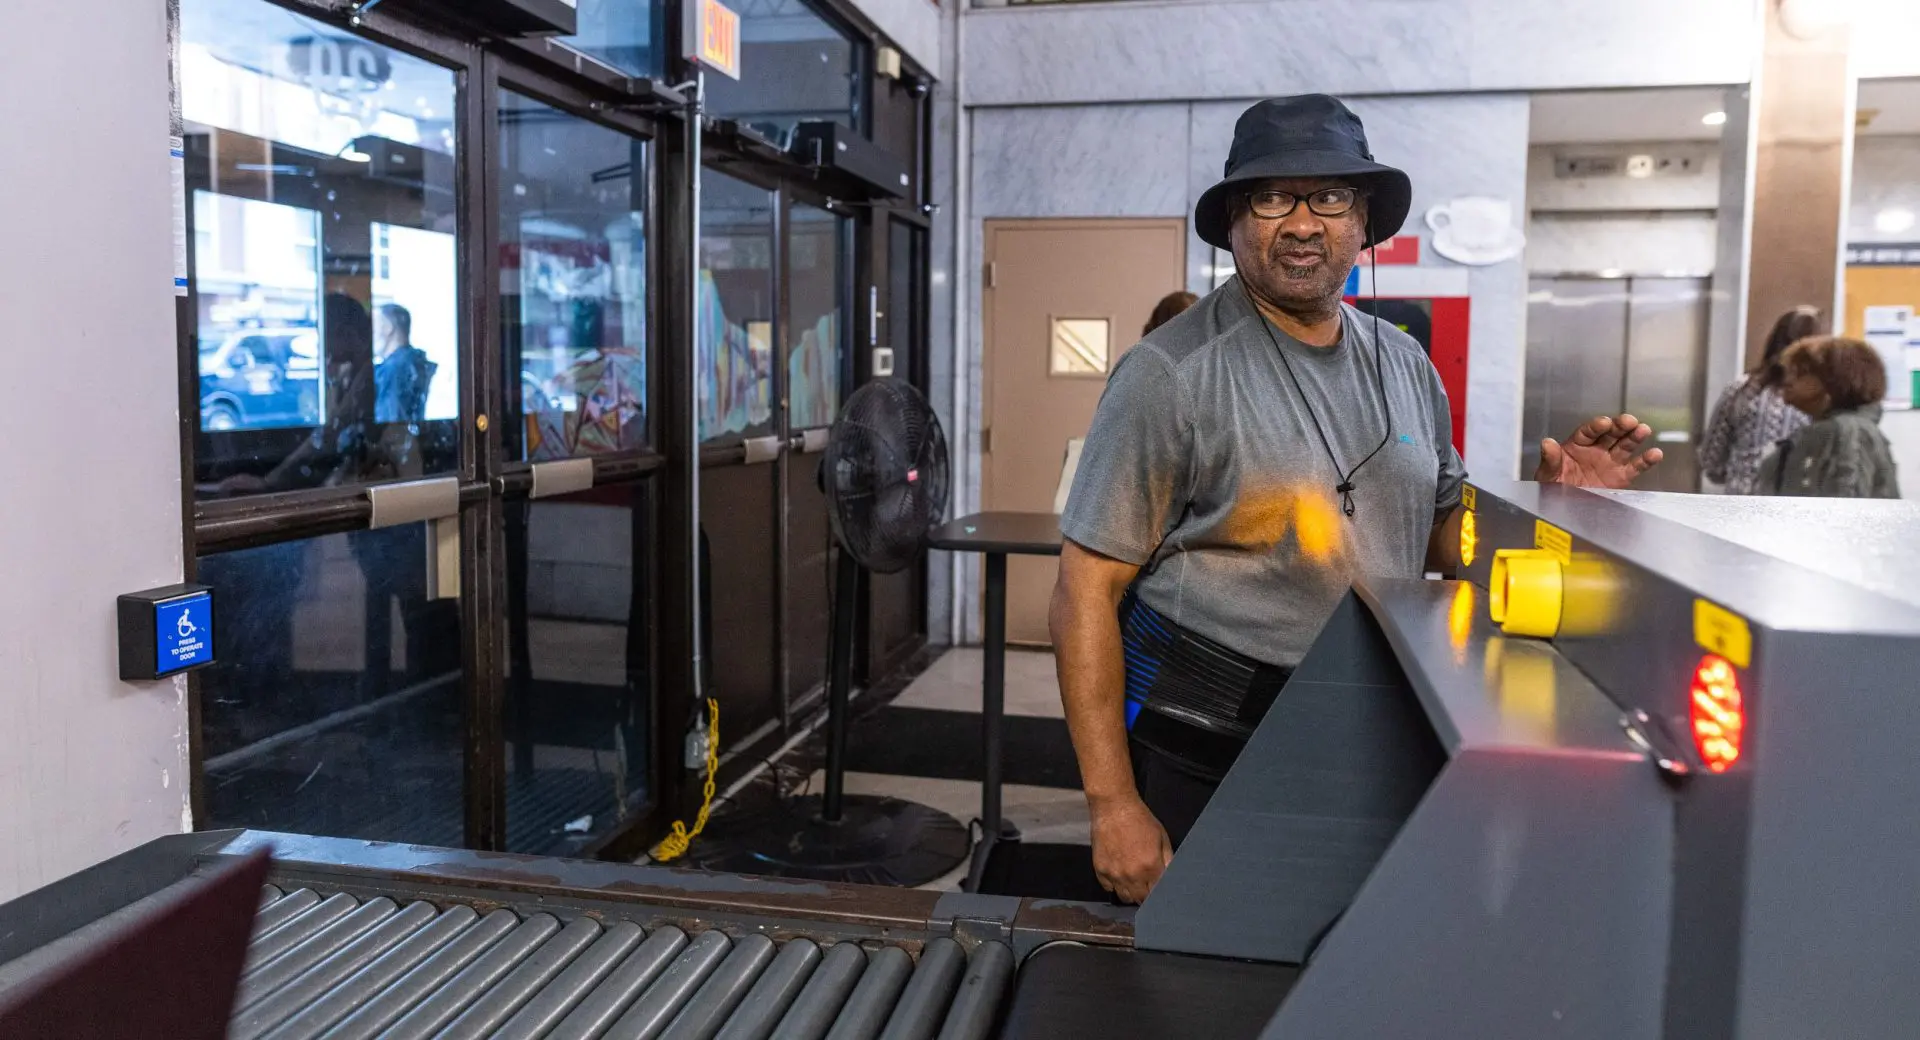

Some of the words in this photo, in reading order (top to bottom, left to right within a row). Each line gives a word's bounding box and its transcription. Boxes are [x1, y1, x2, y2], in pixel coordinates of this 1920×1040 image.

[179, 637, 195, 646] PRESS
[179, 642, 203, 653] OPERATE
[180, 652, 195, 660] DOOR
